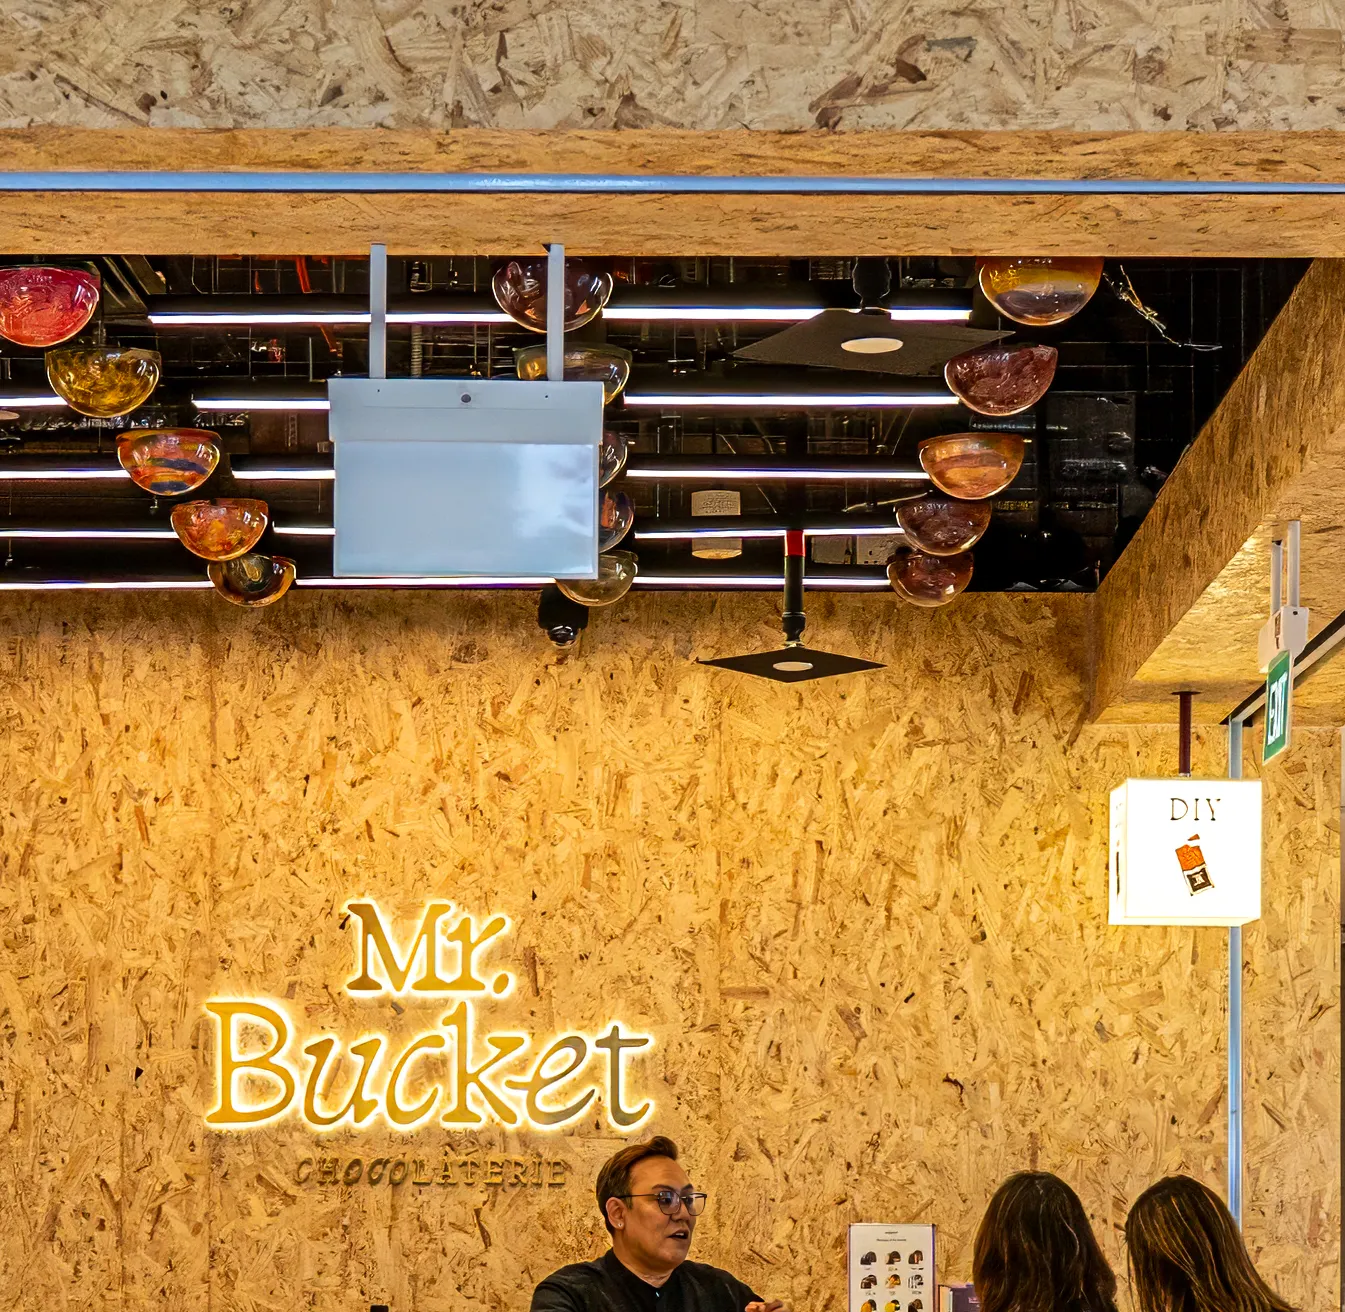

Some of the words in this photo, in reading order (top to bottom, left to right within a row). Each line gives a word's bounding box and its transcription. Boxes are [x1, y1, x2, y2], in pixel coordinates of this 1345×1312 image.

[1267, 672, 1288, 746] EXIT
[1169, 797, 1221, 822] DIY
[346, 902, 510, 995] Mr.
[205, 1000, 651, 1128] Bucket
[294, 1156, 568, 1187] CHOCOLATERIE
